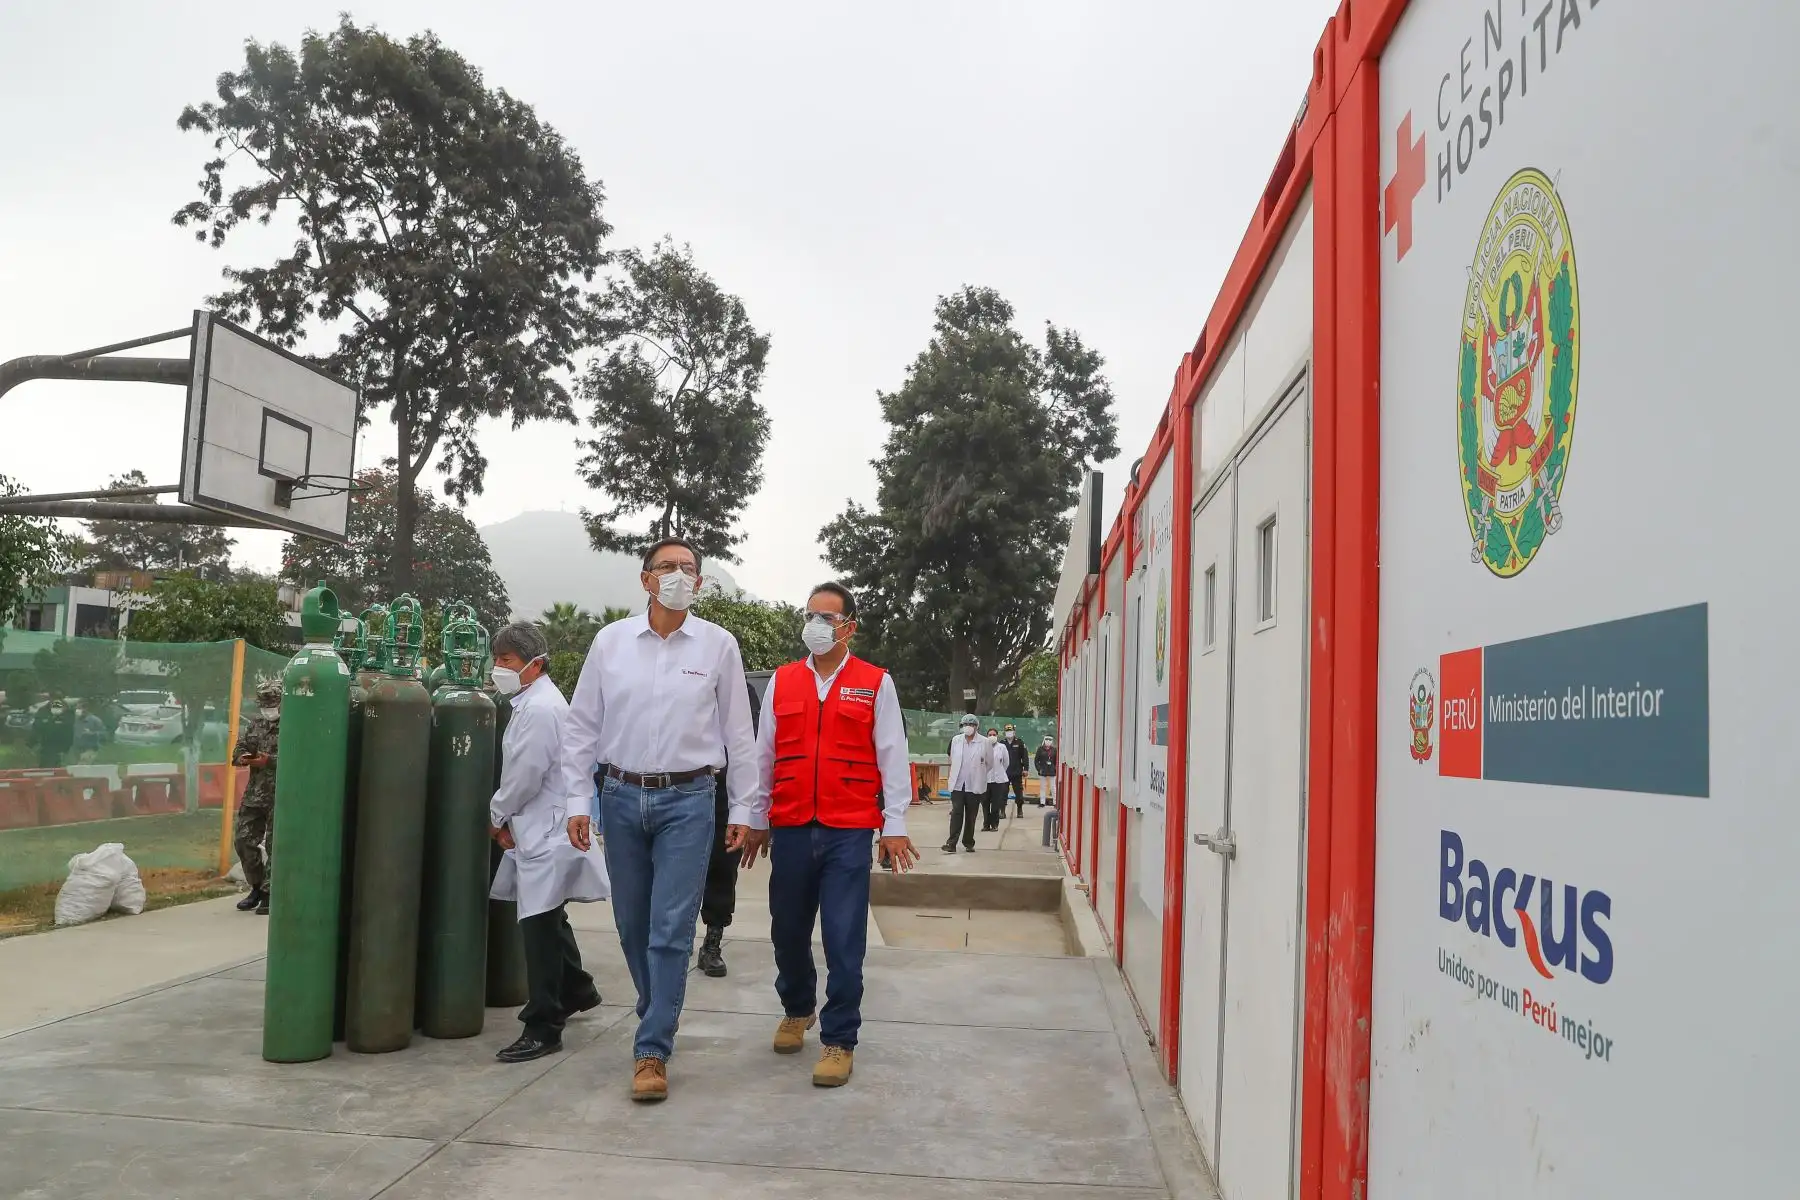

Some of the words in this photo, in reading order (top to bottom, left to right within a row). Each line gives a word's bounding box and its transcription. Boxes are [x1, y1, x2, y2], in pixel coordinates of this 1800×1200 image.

[1437, 0, 1525, 131] CEN
[1437, 0, 1600, 204] HOSPITA
[1503, 187, 1559, 249] NACIONAL
[1500, 487, 1526, 509] PATRIA
[1443, 688, 1476, 730] PERÚ
[1489, 690, 1557, 723] Ministerio
[1561, 685, 1586, 720] del
[1591, 681, 1664, 719] Interior
[1439, 829, 1614, 985] Backus
[1438, 946, 1475, 989] Unidos
[1477, 972, 1499, 1000] por
[1501, 985, 1519, 1013] un
[1522, 988, 1557, 1034] Perú
[1561, 1015, 1613, 1062] mejor
